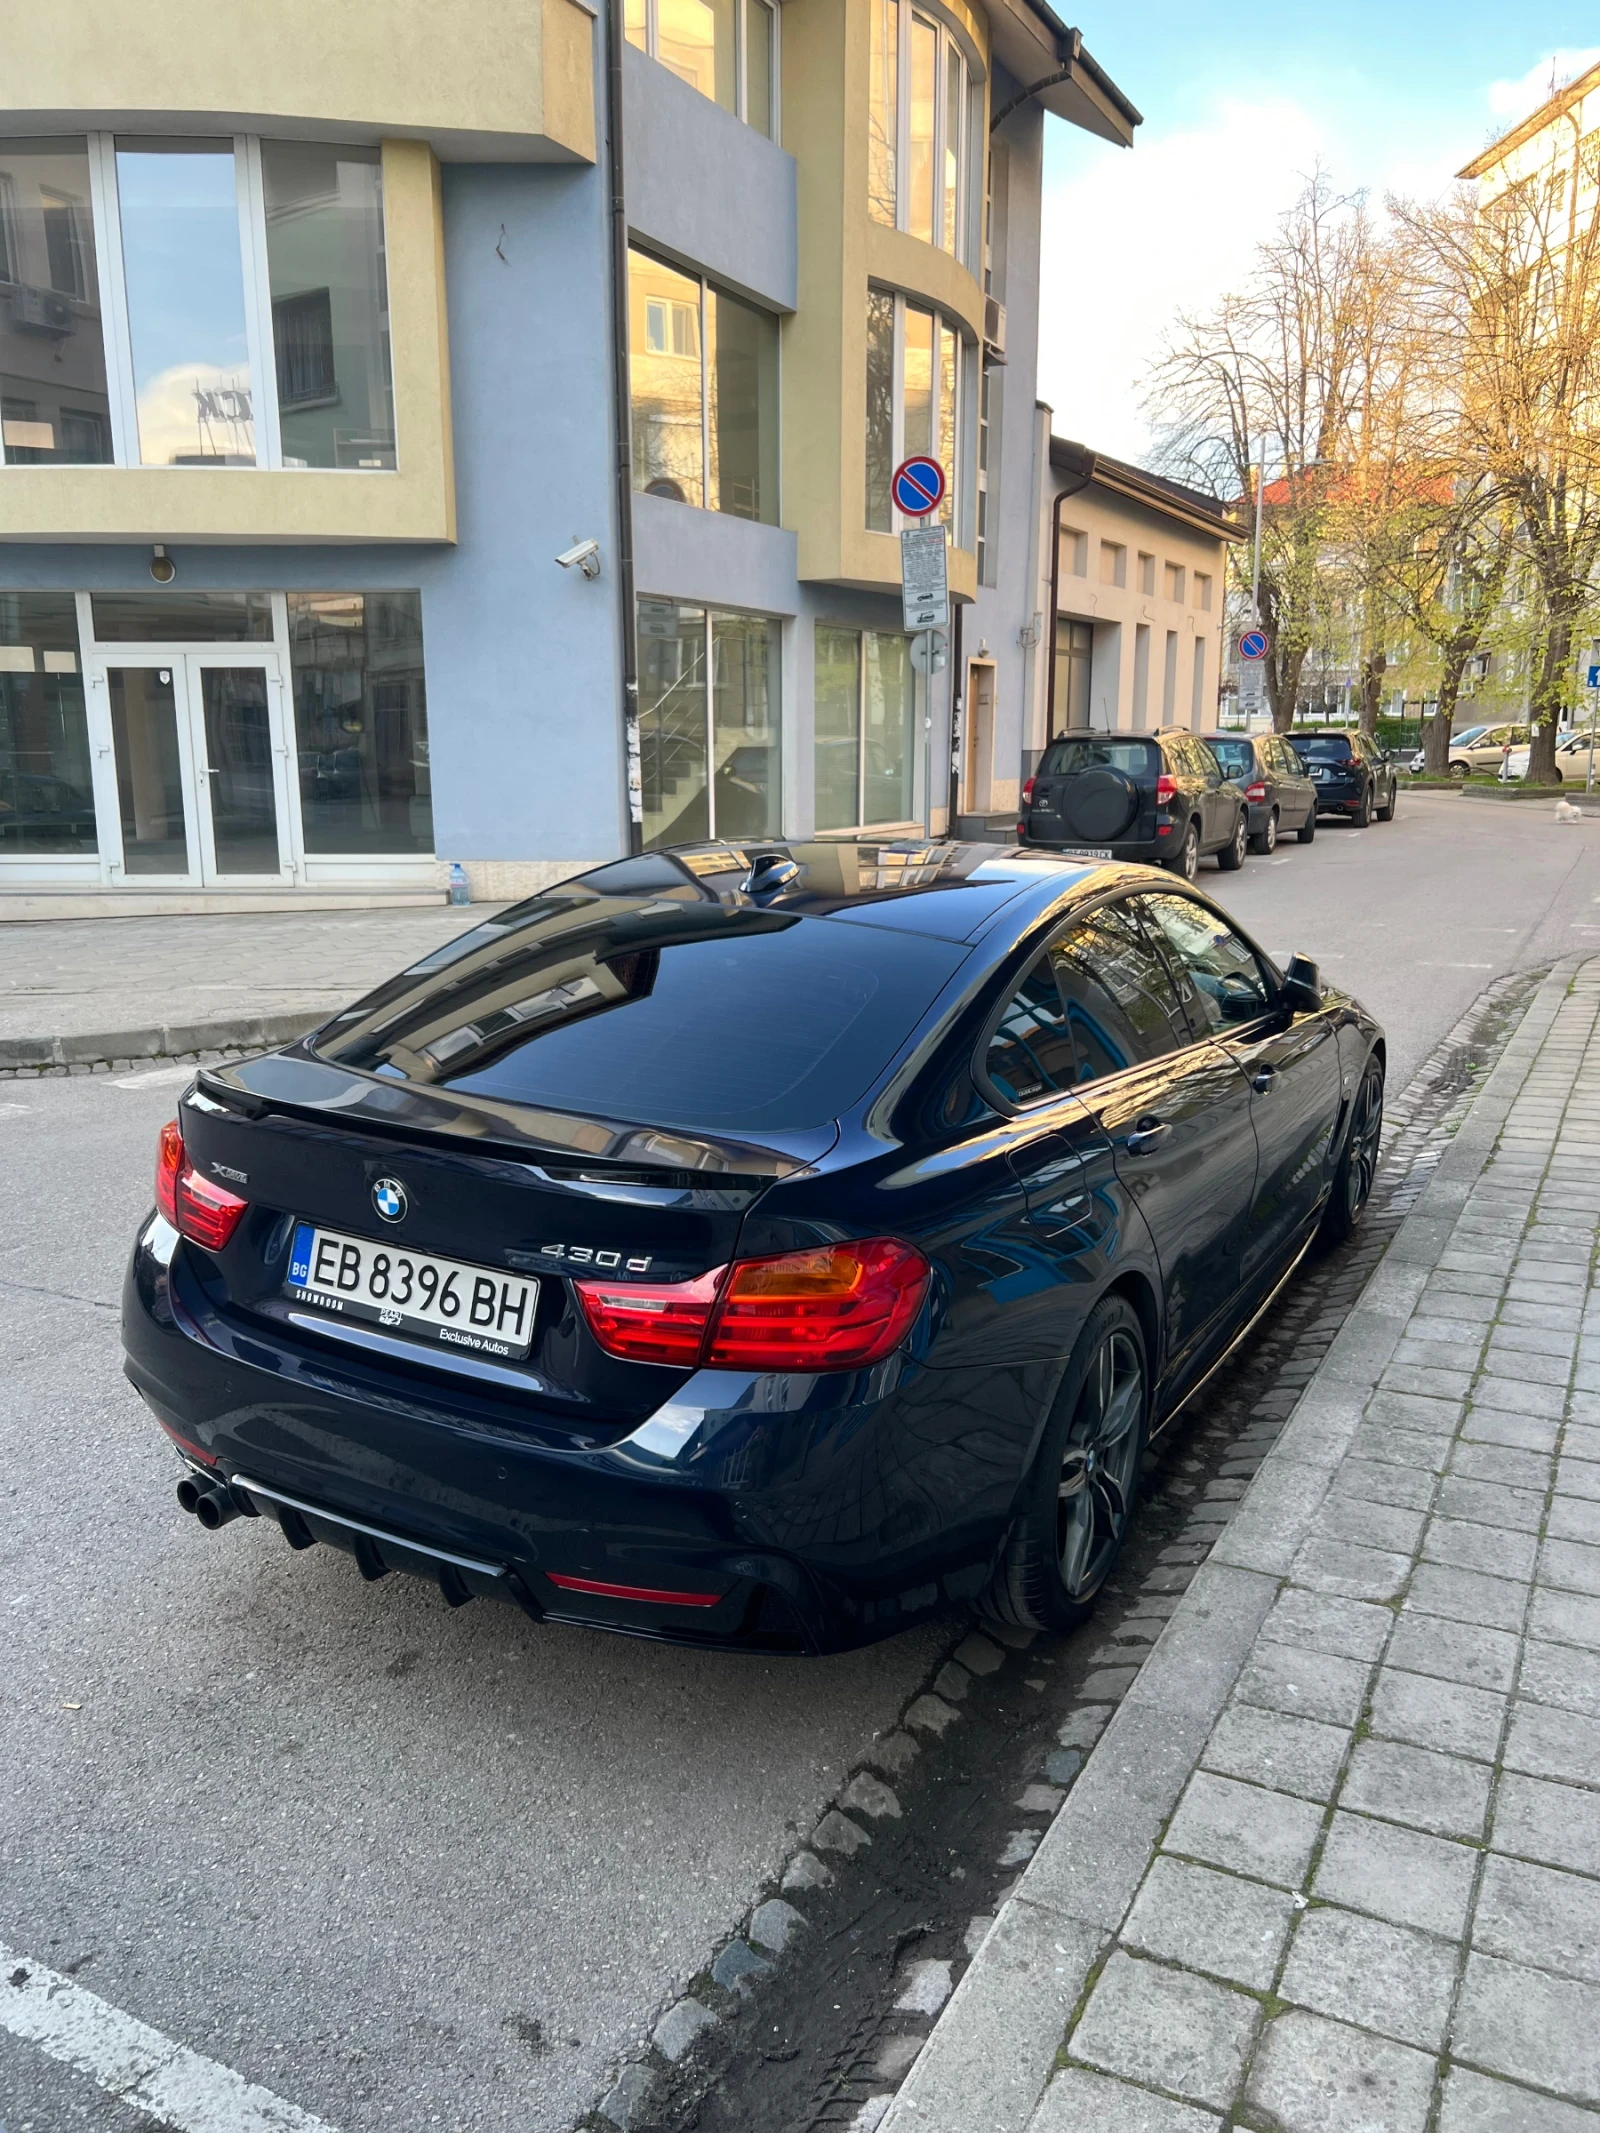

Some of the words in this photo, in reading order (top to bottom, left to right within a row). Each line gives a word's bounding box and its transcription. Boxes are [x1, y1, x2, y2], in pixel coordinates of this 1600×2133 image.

[292, 1261, 308, 1278] BG
[313, 1237, 362, 1292] EB
[368, 1253, 461, 1318] 8396
[468, 1275, 529, 1336] BH
[296, 1289, 344, 1311] SHOWROOM
[440, 1328, 481, 1349] Exclusive
[481, 1339, 509, 1356] Autos
